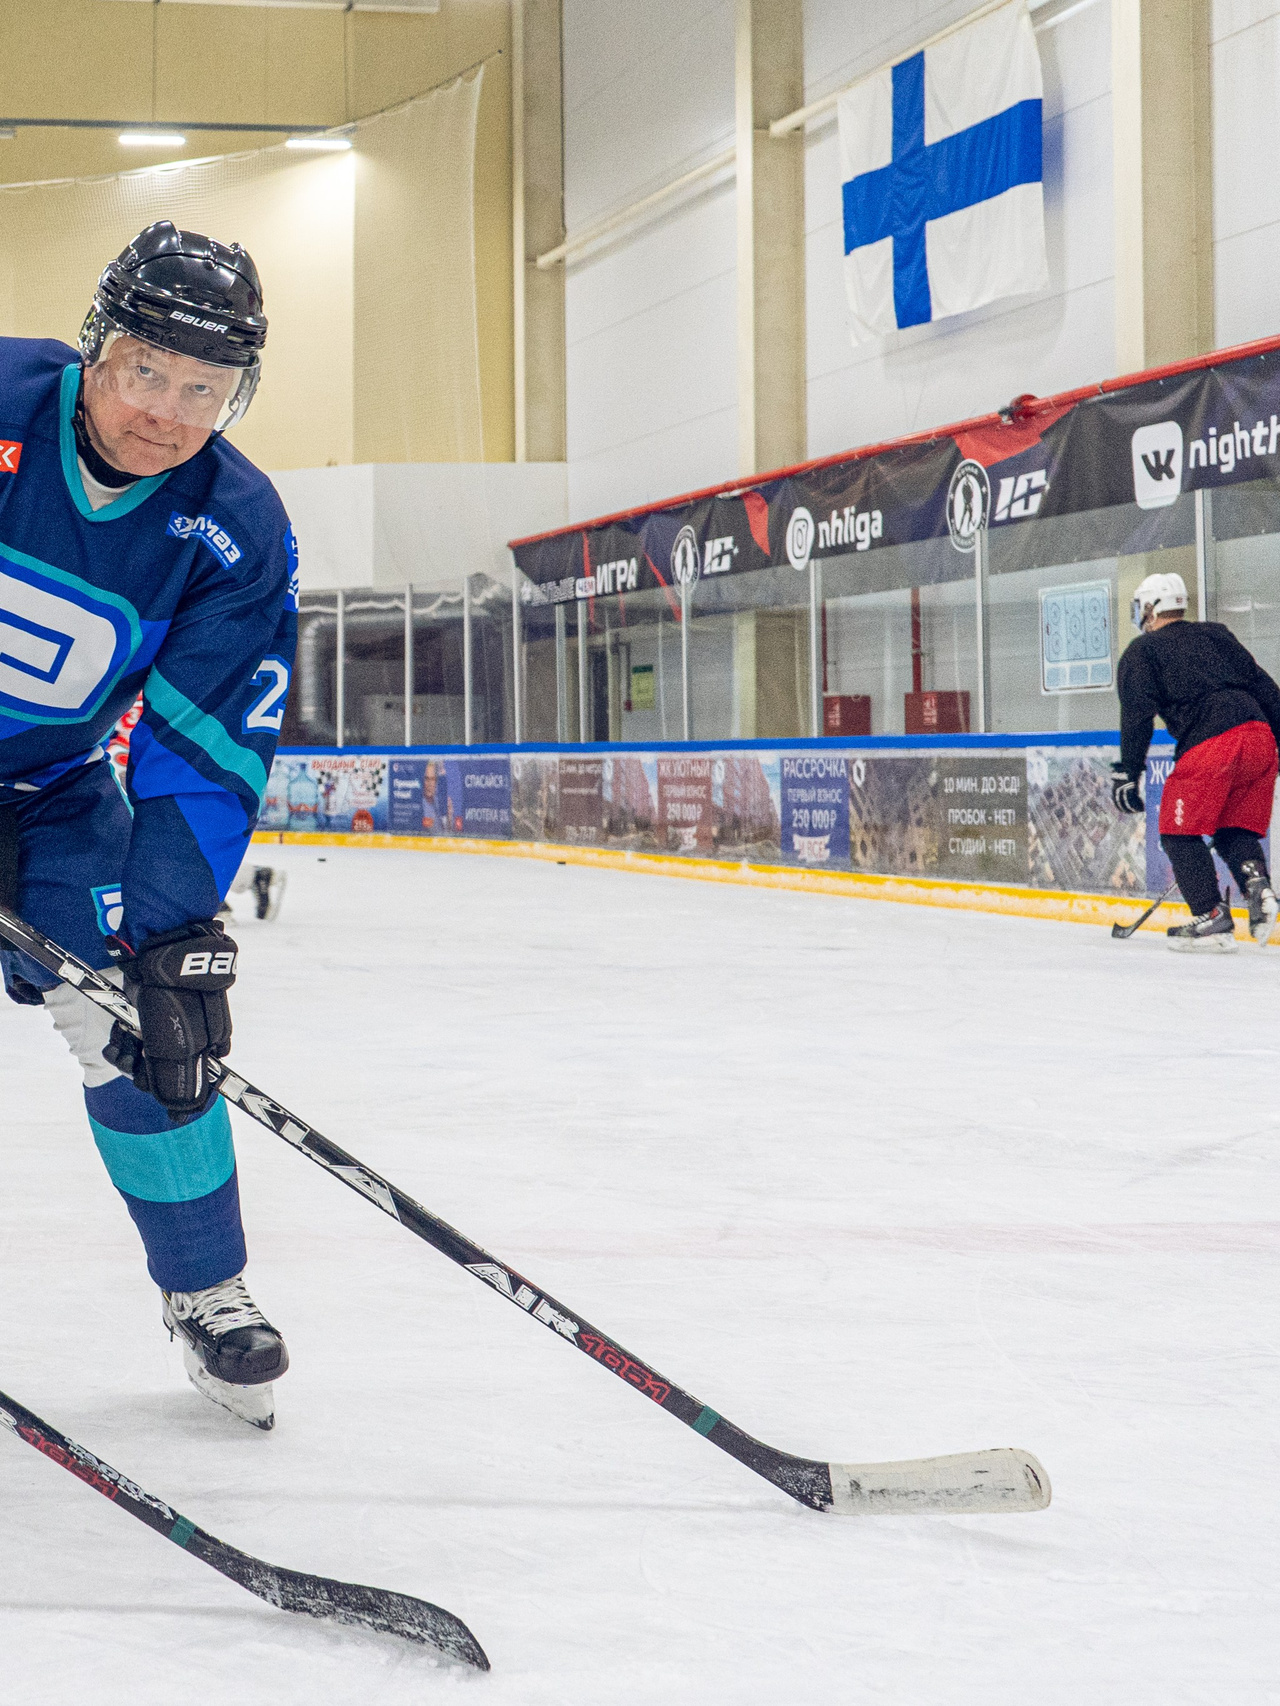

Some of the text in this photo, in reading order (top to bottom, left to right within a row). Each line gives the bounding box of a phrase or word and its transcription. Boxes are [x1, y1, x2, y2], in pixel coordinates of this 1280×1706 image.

[169, 309, 229, 333] BAUER
[818, 506, 883, 550] nhliga
[596, 557, 638, 595] ИГРА
[783, 758, 847, 778] РАССРОЧКА
[944, 776, 954, 793] 10
[981, 776, 996, 795] ДО
[792, 808, 810, 830] 250
[948, 808, 986, 826] ПРОБОК
[949, 836, 986, 856] СТУДИЙ
[462, 1262, 579, 1346] AIR
